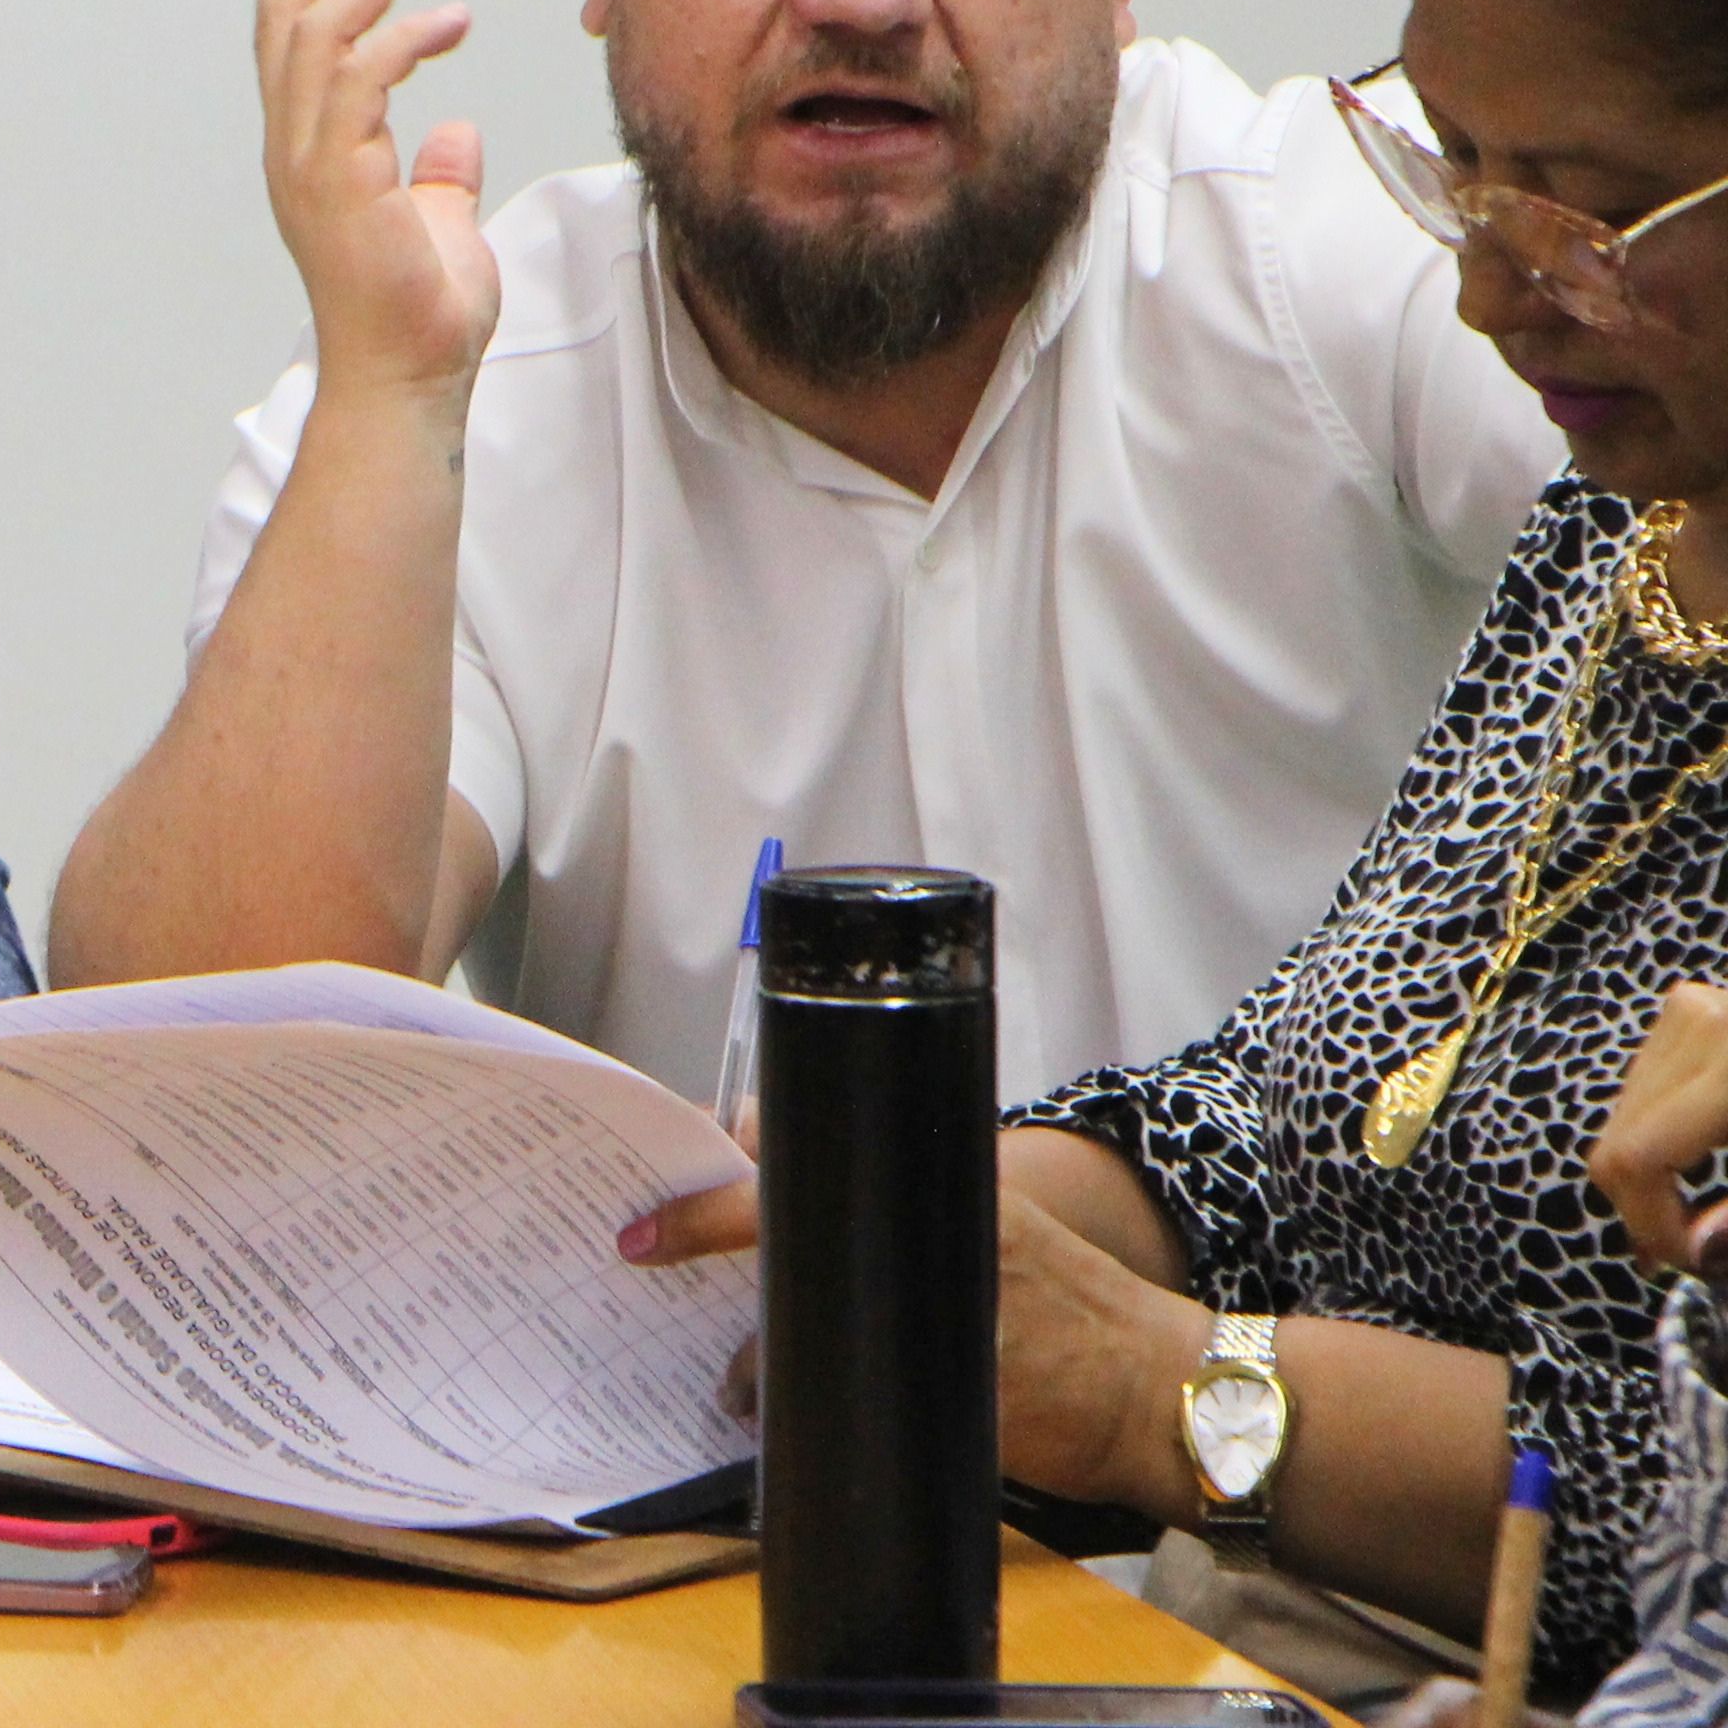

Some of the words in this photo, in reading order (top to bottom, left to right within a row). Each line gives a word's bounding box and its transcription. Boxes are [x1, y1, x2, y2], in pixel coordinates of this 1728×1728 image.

[23, 1152, 99, 1222] POLÍTICAS
[103, 1194, 157, 1249] RACIAL
[21, 1198, 106, 1293] Direitos
[91, 1216, 120, 1245] DE
[113, 1238, 190, 1323] REGIONAL
[149, 1245, 236, 1339] IGUALDADE
[204, 1247, 252, 1297] setembro
[71, 1308, 113, 1353] GRANDE
[105, 1296, 183, 1377] Social
[230, 1335, 258, 1364] DA
[185, 1319, 319, 1446] COORDENADORIA
[250, 1360, 347, 1442] PROMOÇÃO
